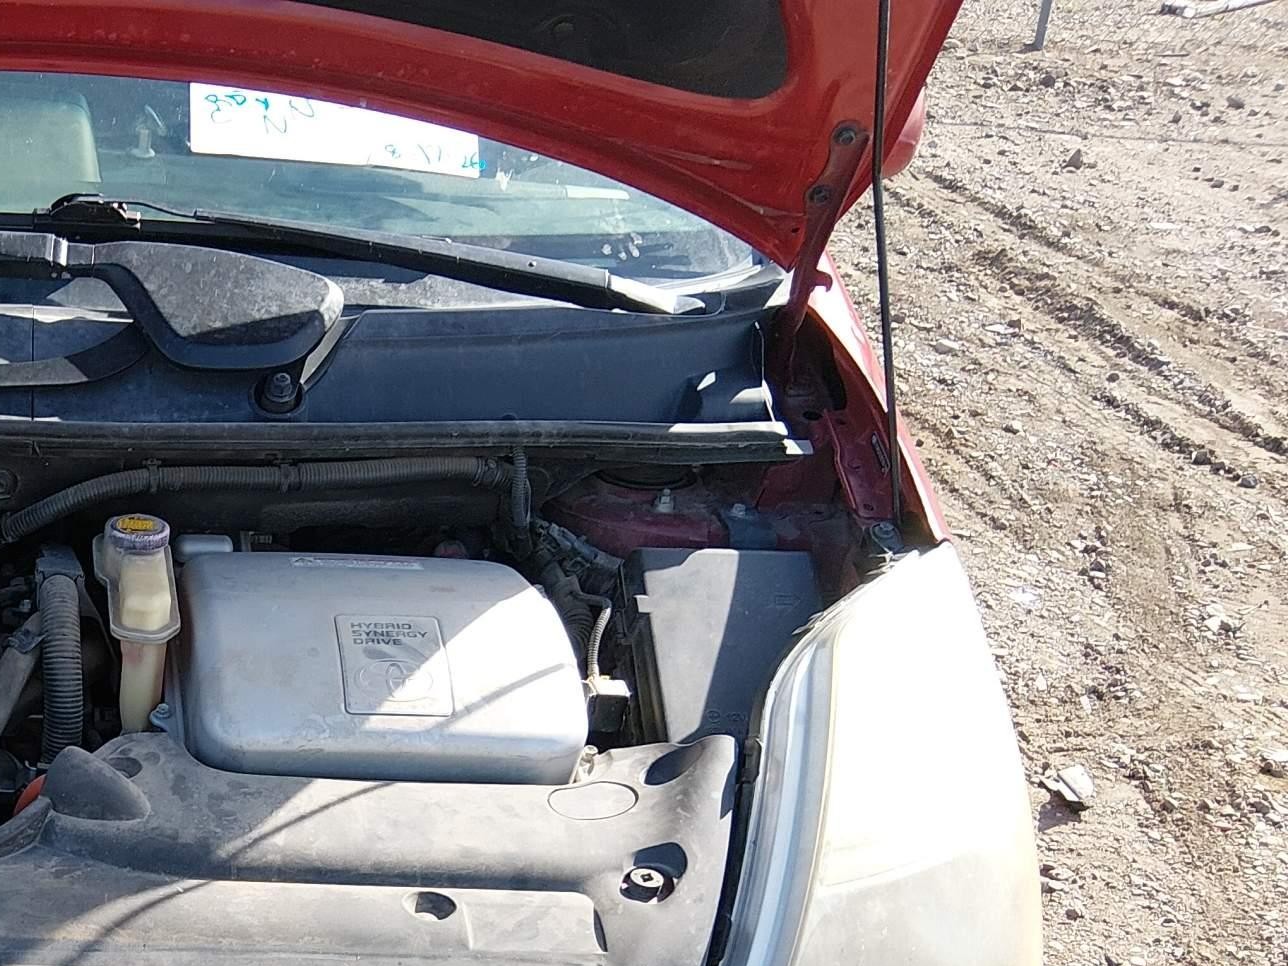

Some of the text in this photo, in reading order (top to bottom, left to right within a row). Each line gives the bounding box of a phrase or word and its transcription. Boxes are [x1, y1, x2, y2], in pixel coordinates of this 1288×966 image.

[350, 622, 412, 630] HYBRID
[351, 630, 428, 638] SYNERGY
[353, 638, 403, 646] DRIVE
